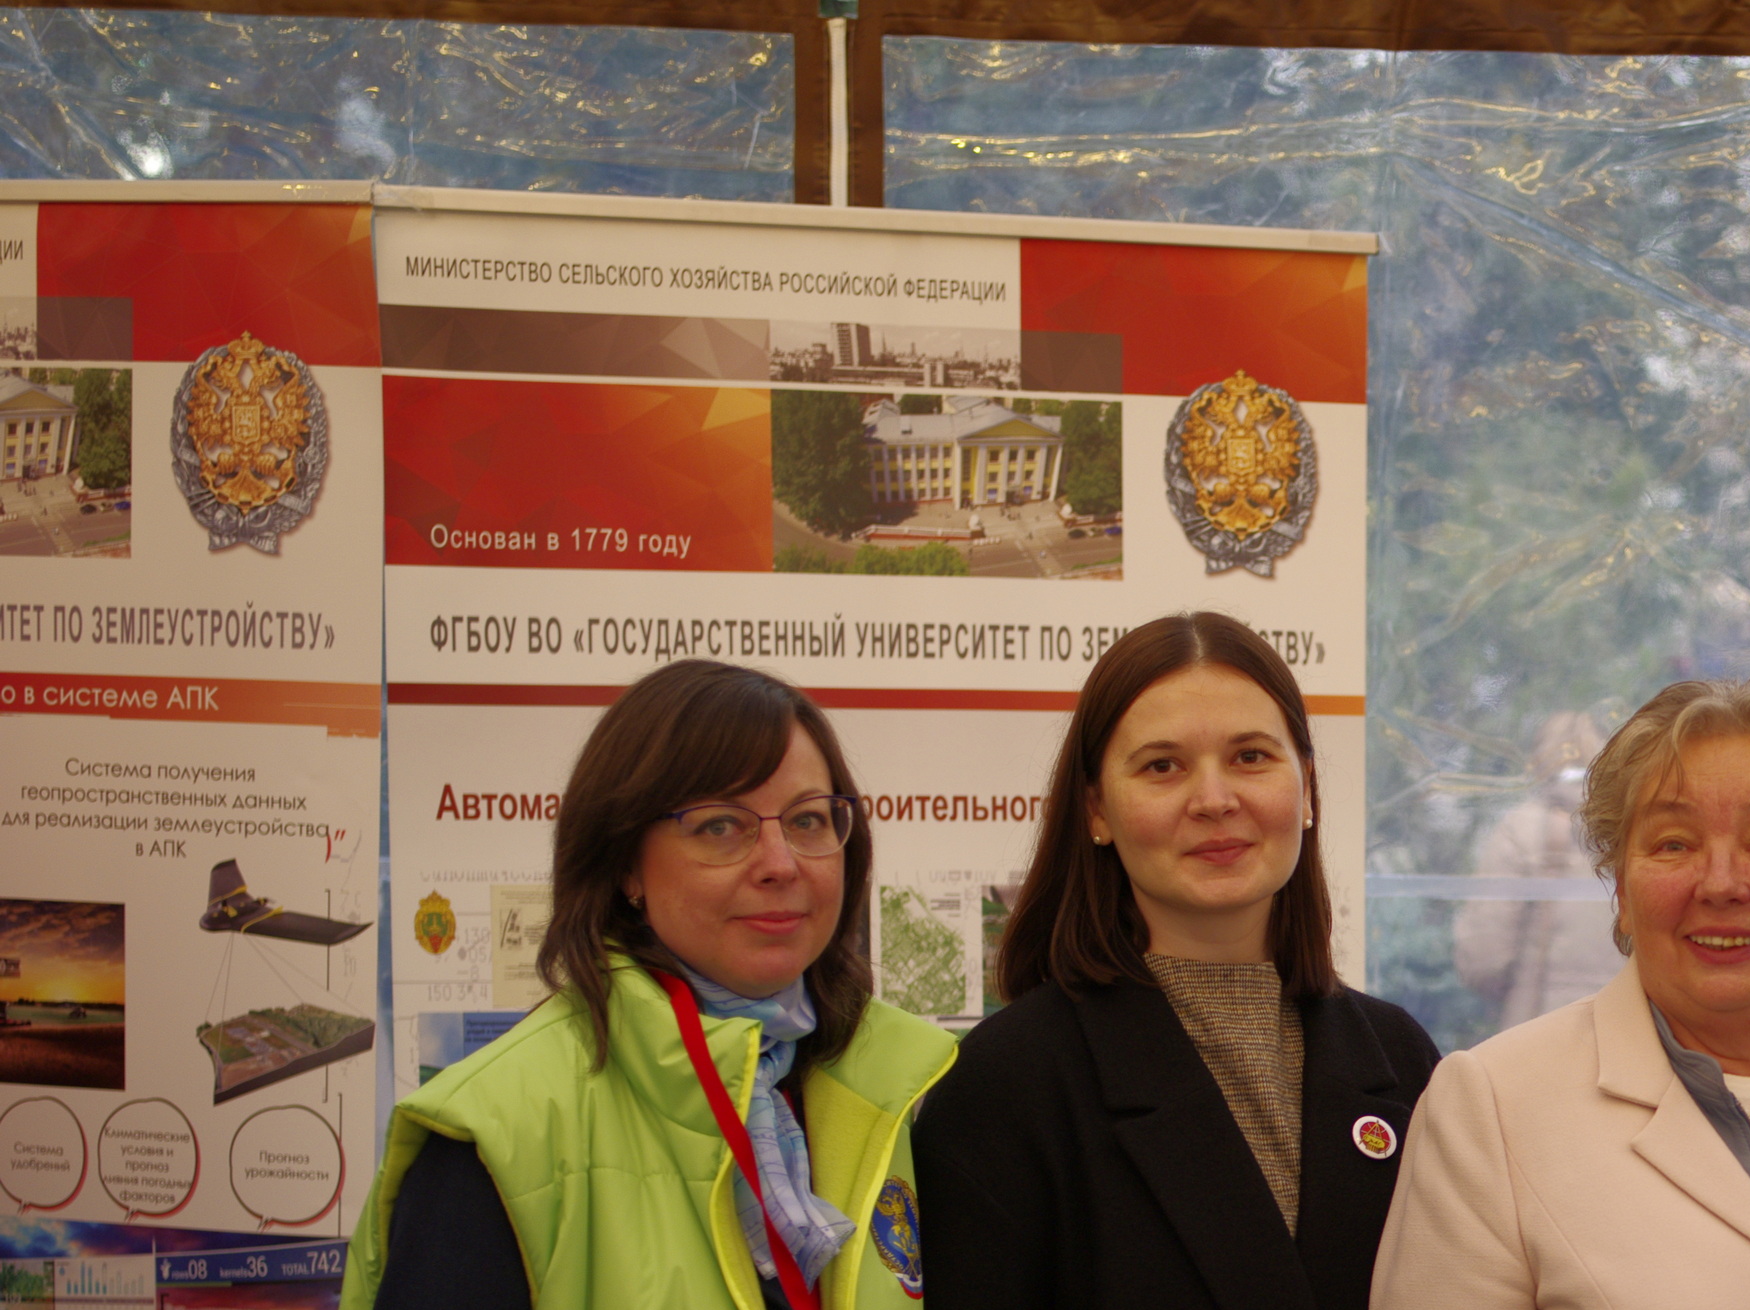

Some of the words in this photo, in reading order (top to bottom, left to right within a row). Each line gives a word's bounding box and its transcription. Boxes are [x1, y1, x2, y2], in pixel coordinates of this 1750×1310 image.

[405, 256, 552, 283] МИНИСТЕРСТВО
[558, 262, 664, 288] СЕЛЬСКОГО
[669, 265, 773, 292] ХОЗЯЙСТВА
[779, 271, 898, 298] РОССИЙСКОЙ
[903, 278, 1007, 305] ФЕДЕРАЦИИ
[430, 523, 536, 551] Основан
[547, 531, 559, 551] в
[570, 527, 628, 552] 1779
[638, 529, 692, 559] году
[53, 605, 83, 645] ПО
[91, 601, 336, 650] ЗЕМЛЕУСТРОЙСТВУ»
[430, 614, 518, 654] ФГБОУ
[528, 617, 563, 654] ВО
[574, 613, 846, 662] «ГОСУДАРСТВЕННЫЙ
[856, 621, 1030, 662] УНИВЕРСИТЕТ
[1040, 625, 1072, 662] ПО
[24, 686, 35, 705] в
[43, 687, 158, 708] системе
[166, 685, 219, 711] АПК
[65, 757, 152, 779] Система
[157, 765, 256, 783] получения
[21, 785, 228, 808] геопространственных
[232, 795, 307, 811] данных
[2, 810, 30, 827] для
[35, 811, 149, 831] реализации
[154, 816, 330, 839] землеустройства
[135, 843, 144, 857] в
[149, 840, 187, 858] АПК
[14, 1142, 64, 1156] Система
[259, 1150, 310, 1166] Прогноз
[244, 1166, 330, 1183] урожайности
[188, 1258, 208, 1280] 08
[246, 1255, 268, 1278] 36
[307, 1249, 342, 1274] 742
